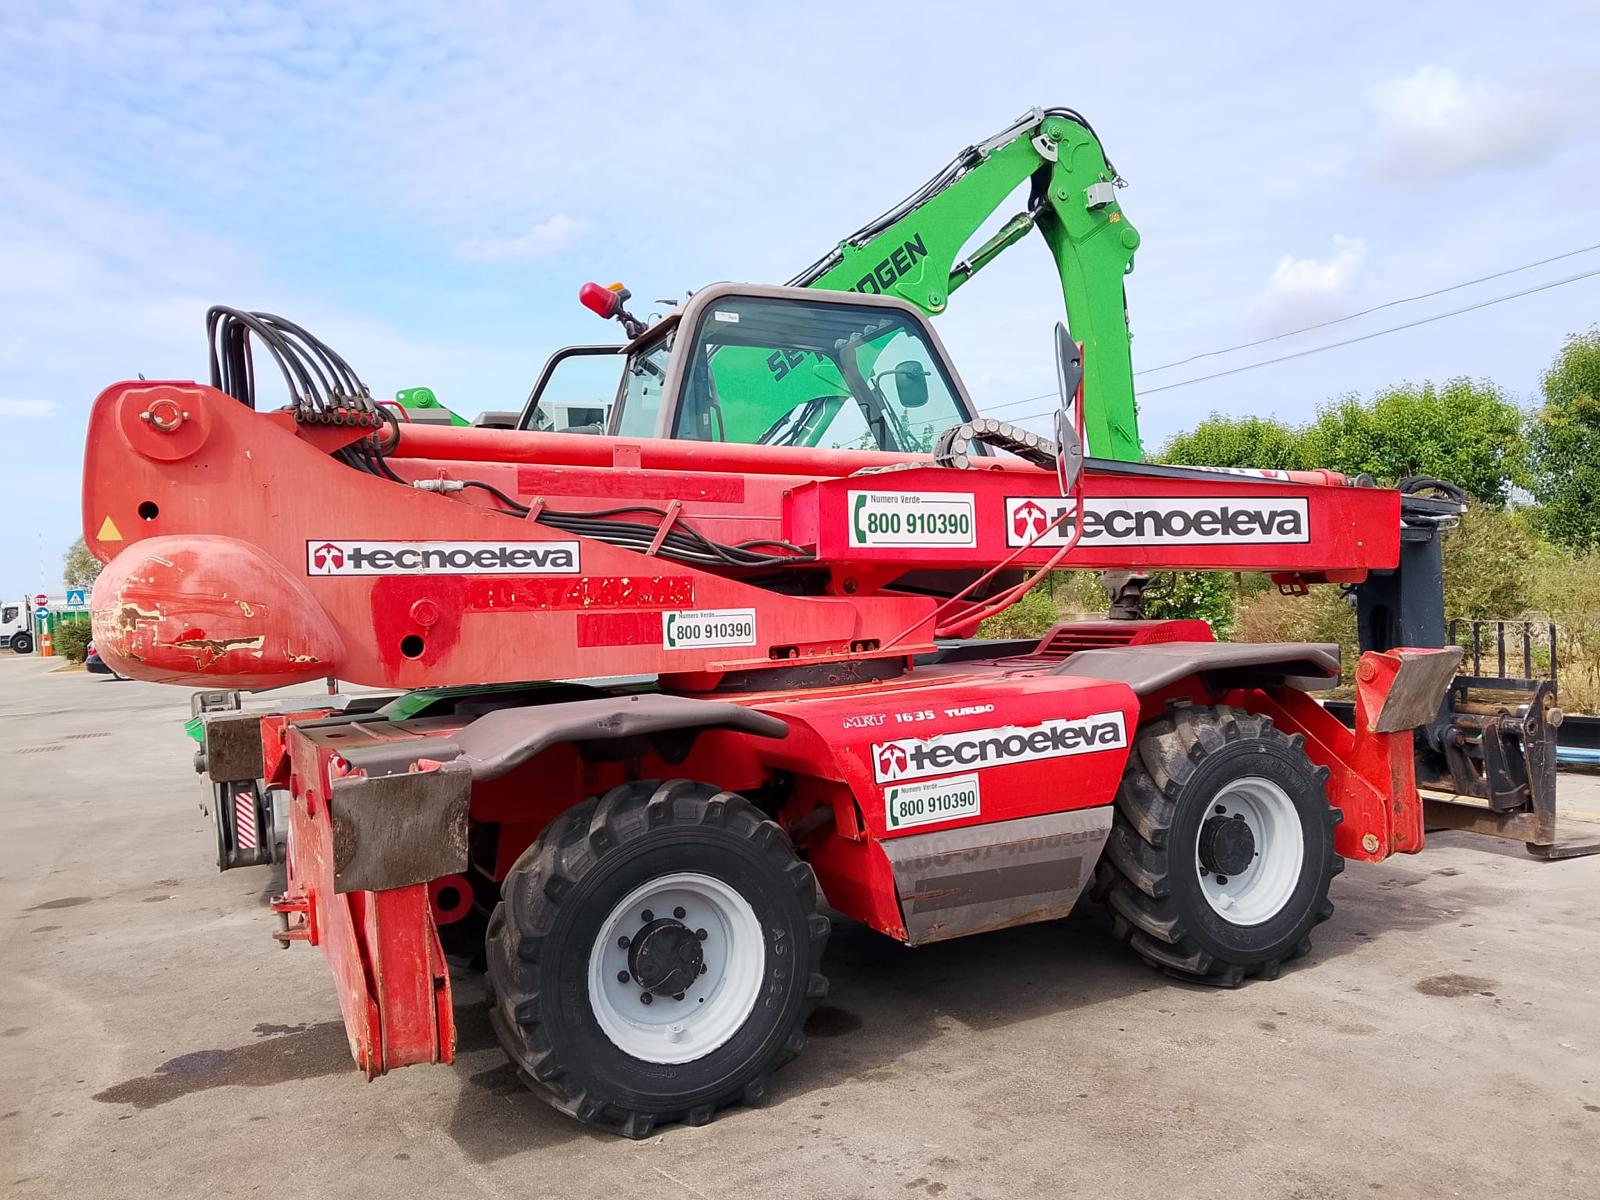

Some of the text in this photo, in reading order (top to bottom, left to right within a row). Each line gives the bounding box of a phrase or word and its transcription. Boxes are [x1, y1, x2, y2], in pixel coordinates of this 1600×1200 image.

[871, 493, 921, 503] Numero Verde
[868, 512, 969, 535] 800 910390
[1051, 505, 1303, 538] tecnoeleva
[347, 547, 574, 570] tecnoeleva
[677, 622, 751, 640] 800 910390
[843, 713, 887, 729] MRT
[943, 704, 995, 718] TURBO
[911, 721, 1121, 771] tecnoeleva
[900, 790, 976, 818] 800 910390
